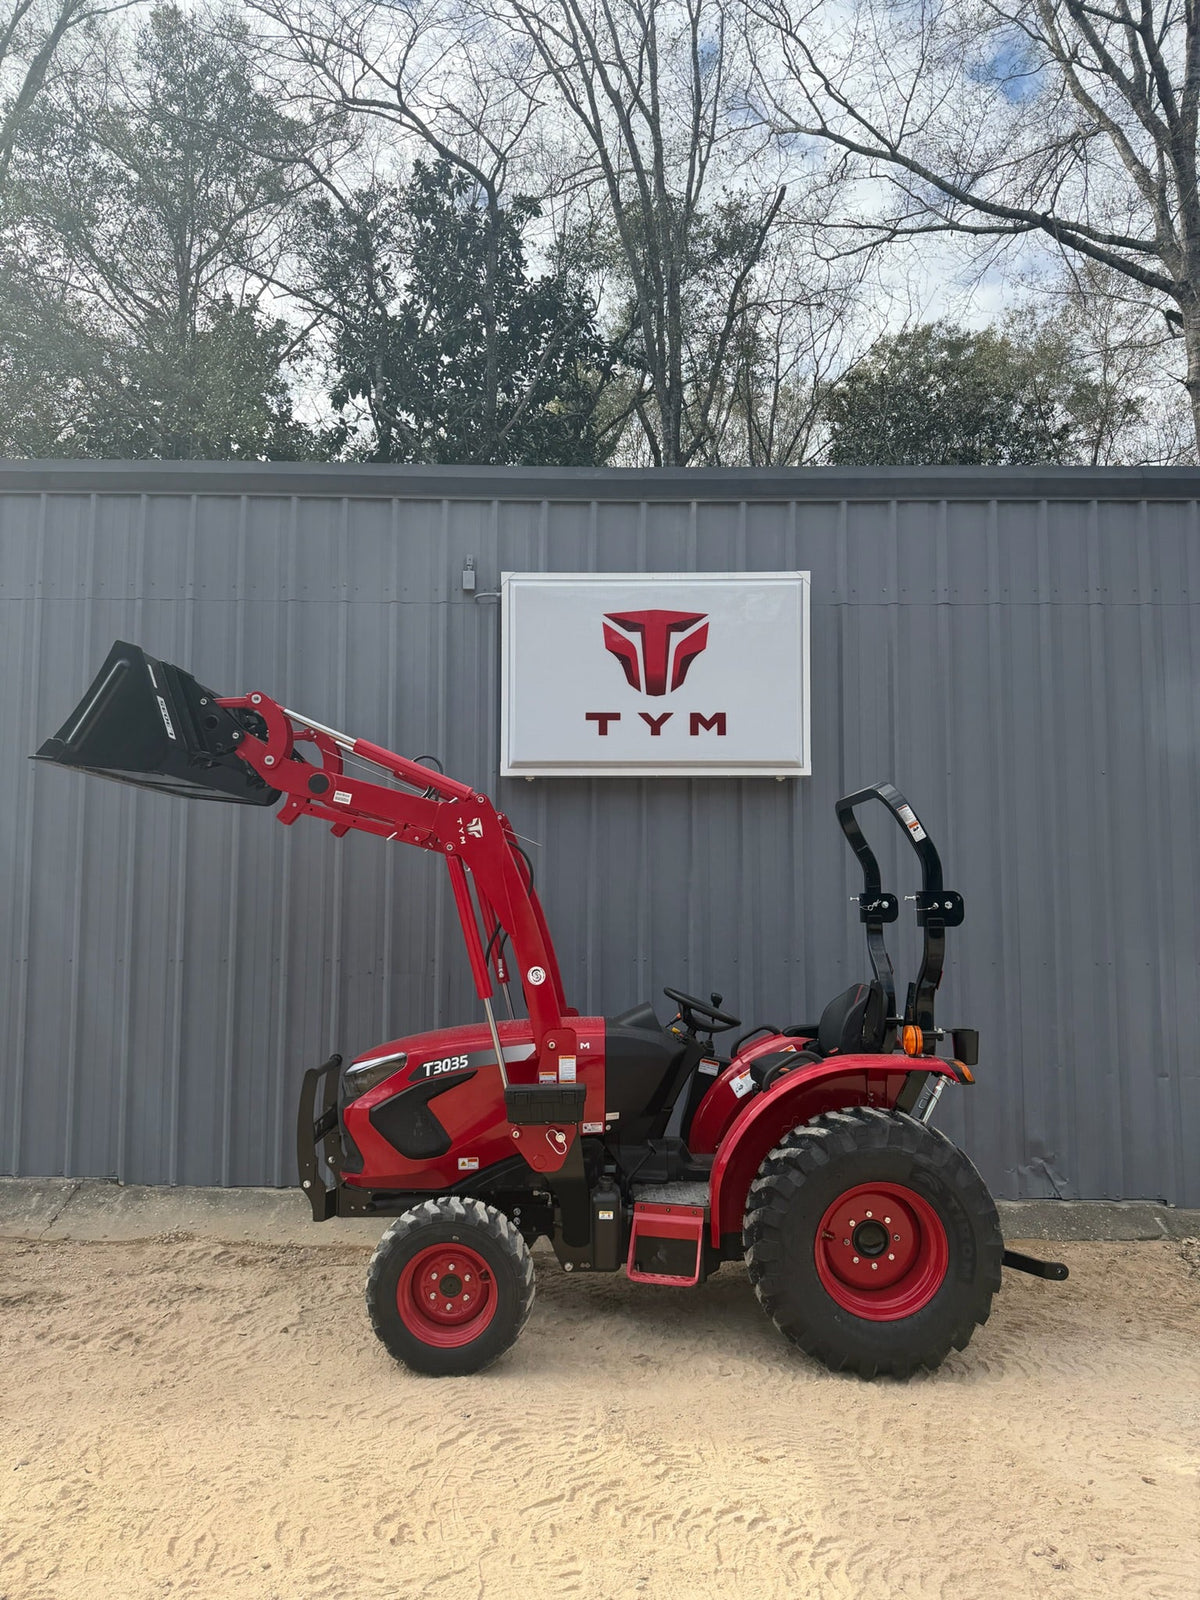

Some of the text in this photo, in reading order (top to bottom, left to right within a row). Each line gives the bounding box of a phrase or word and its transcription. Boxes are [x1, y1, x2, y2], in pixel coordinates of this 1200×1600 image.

[585, 712, 727, 736] TYM
[456, 817, 467, 844] TYM
[422, 1054, 469, 1077] T3035
